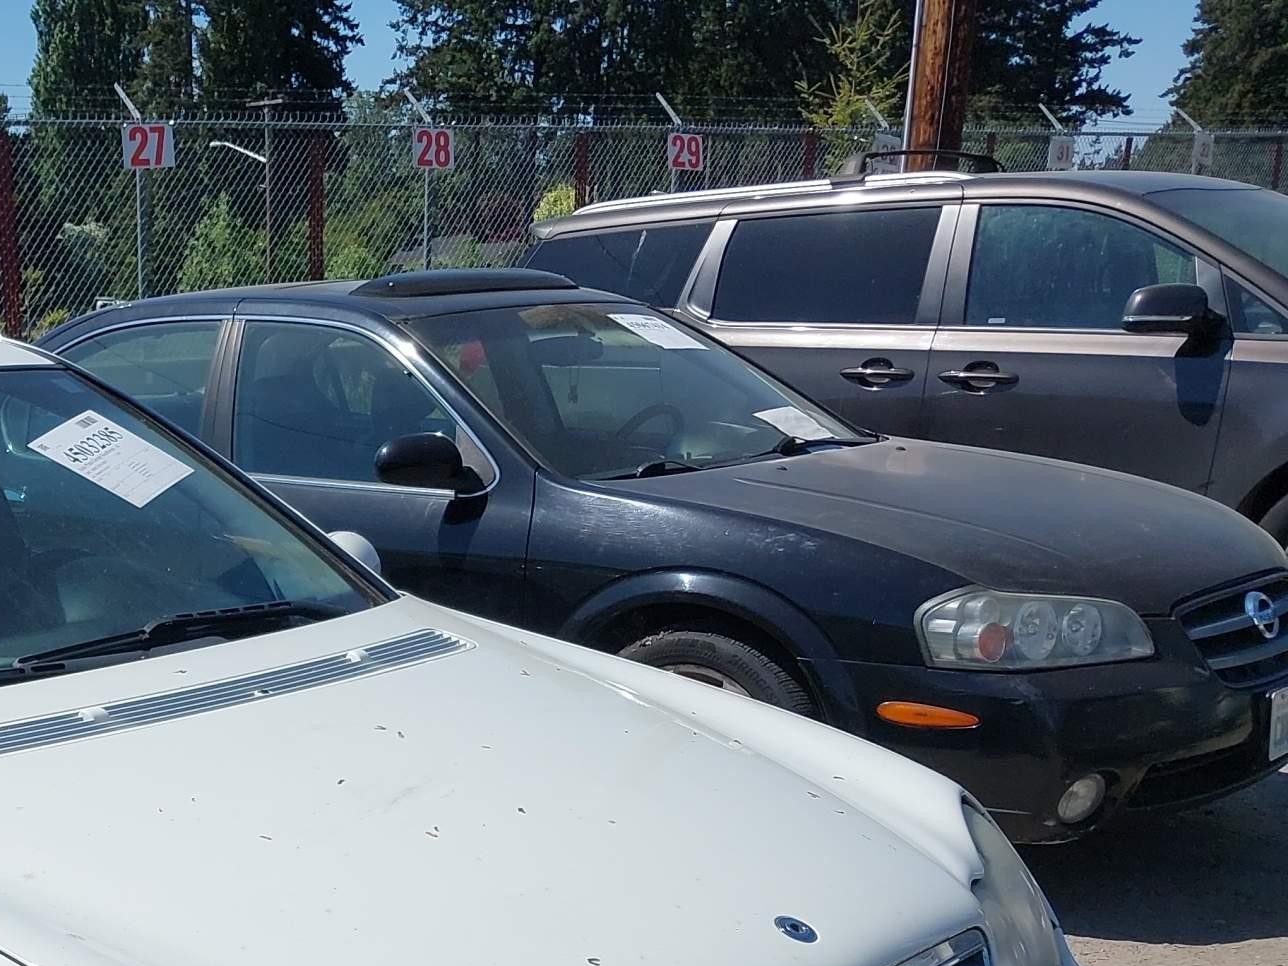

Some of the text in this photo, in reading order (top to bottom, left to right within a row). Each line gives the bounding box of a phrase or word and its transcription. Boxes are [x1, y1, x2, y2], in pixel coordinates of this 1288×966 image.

[129, 126, 165, 166] 27
[417, 130, 450, 167] 28
[672, 135, 700, 168] 29
[1056, 143, 1070, 161] 31
[63, 427, 124, 463] 45032385
